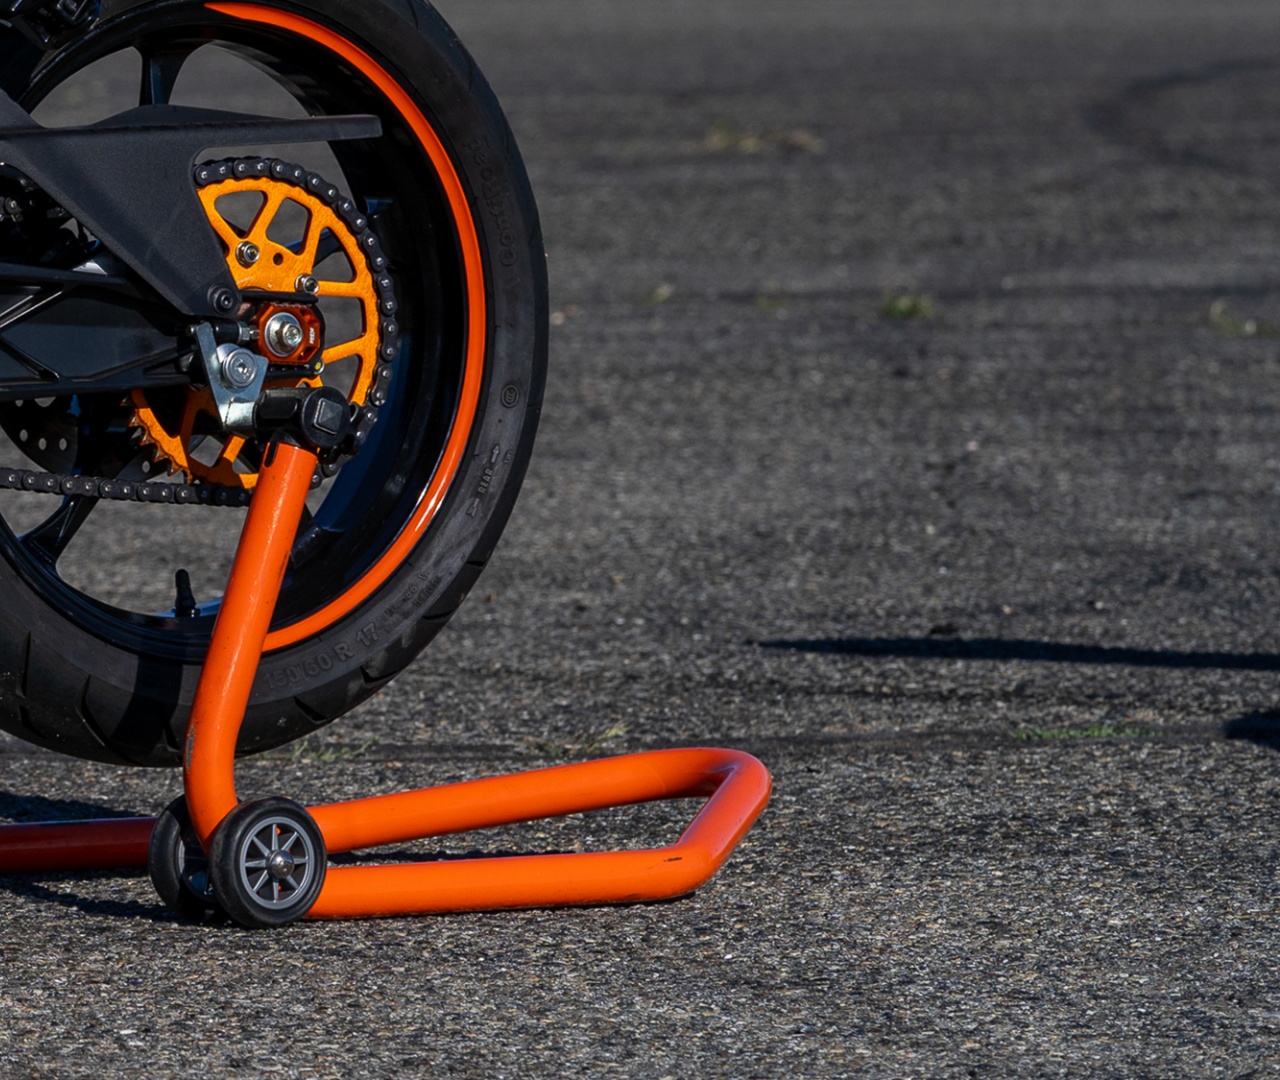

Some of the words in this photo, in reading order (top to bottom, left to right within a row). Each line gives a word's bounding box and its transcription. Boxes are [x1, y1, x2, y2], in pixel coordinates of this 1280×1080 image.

[476, 468, 494, 495] REAR
[263, 651, 333, 690] 150/60
[333, 641, 355, 662] R
[356, 622, 380, 647] 17
